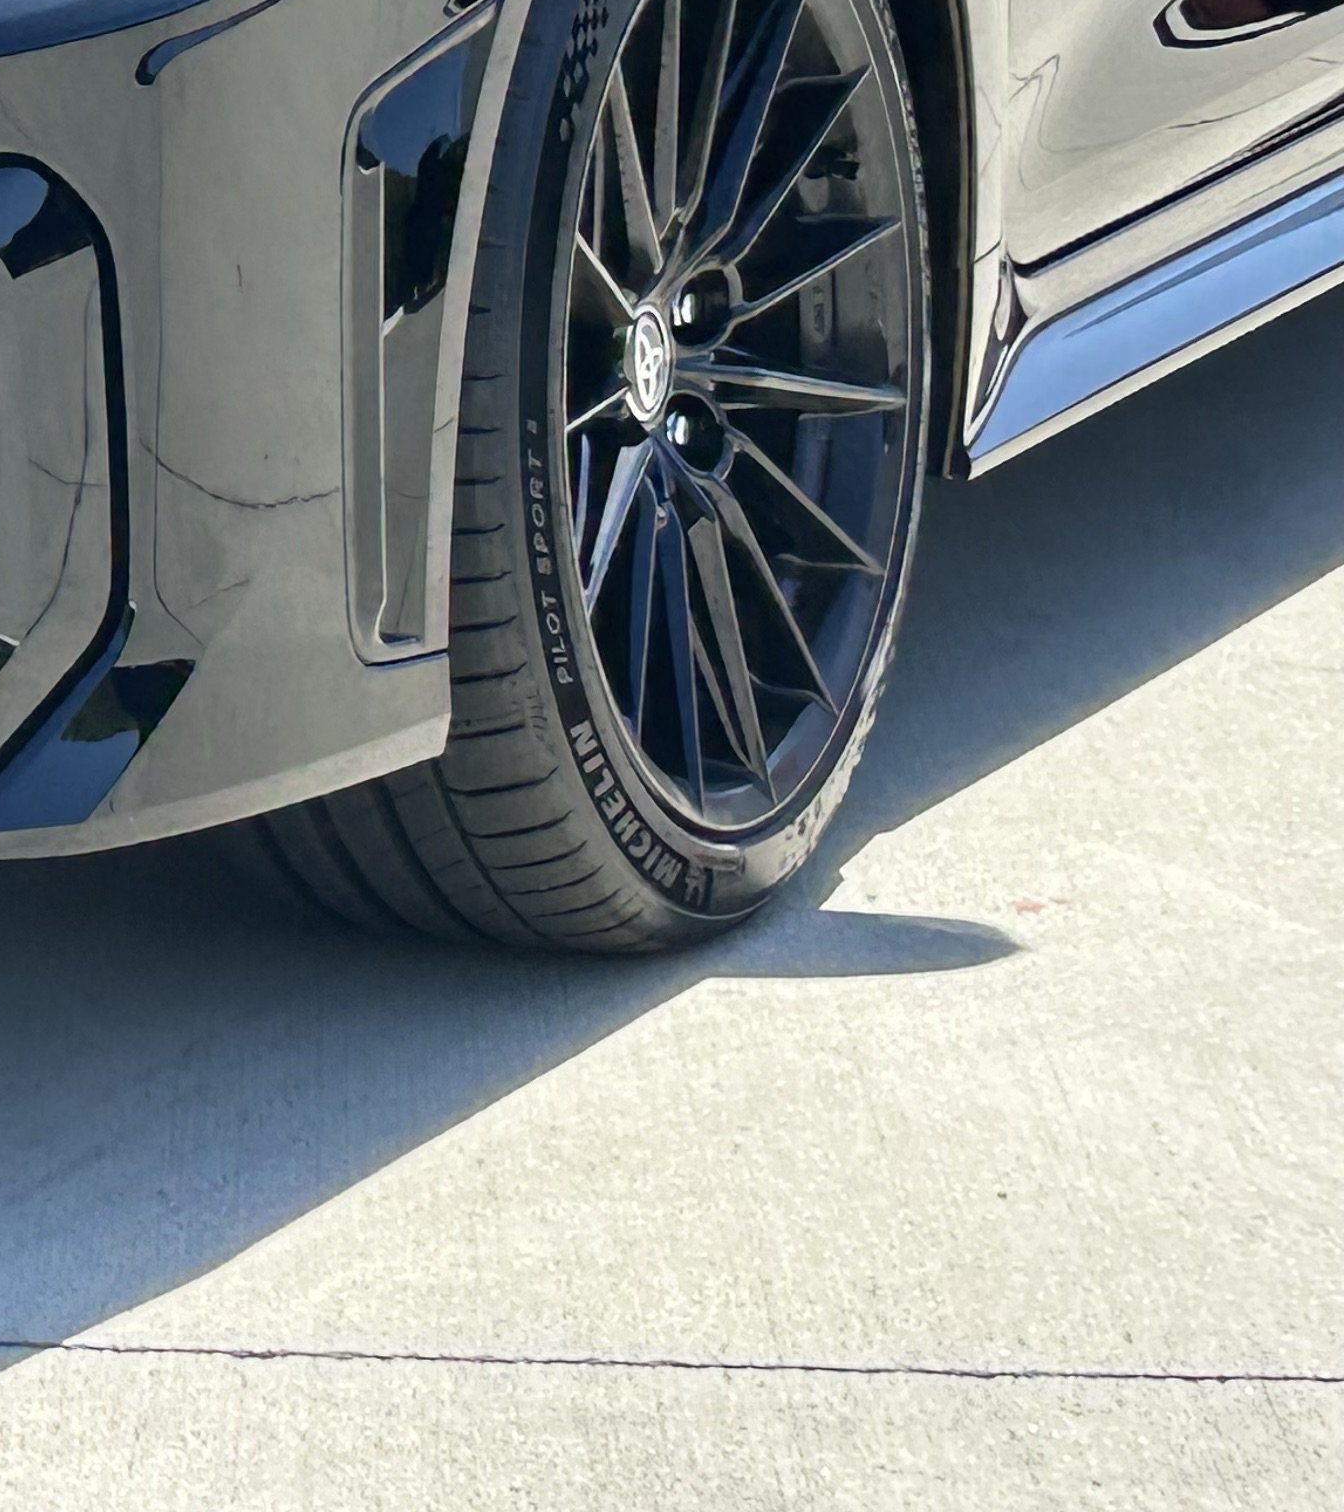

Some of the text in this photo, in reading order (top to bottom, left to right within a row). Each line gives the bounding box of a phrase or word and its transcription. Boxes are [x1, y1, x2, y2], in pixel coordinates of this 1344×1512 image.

[527, 448, 683, 889] MICHELIN PILOT SPORT
